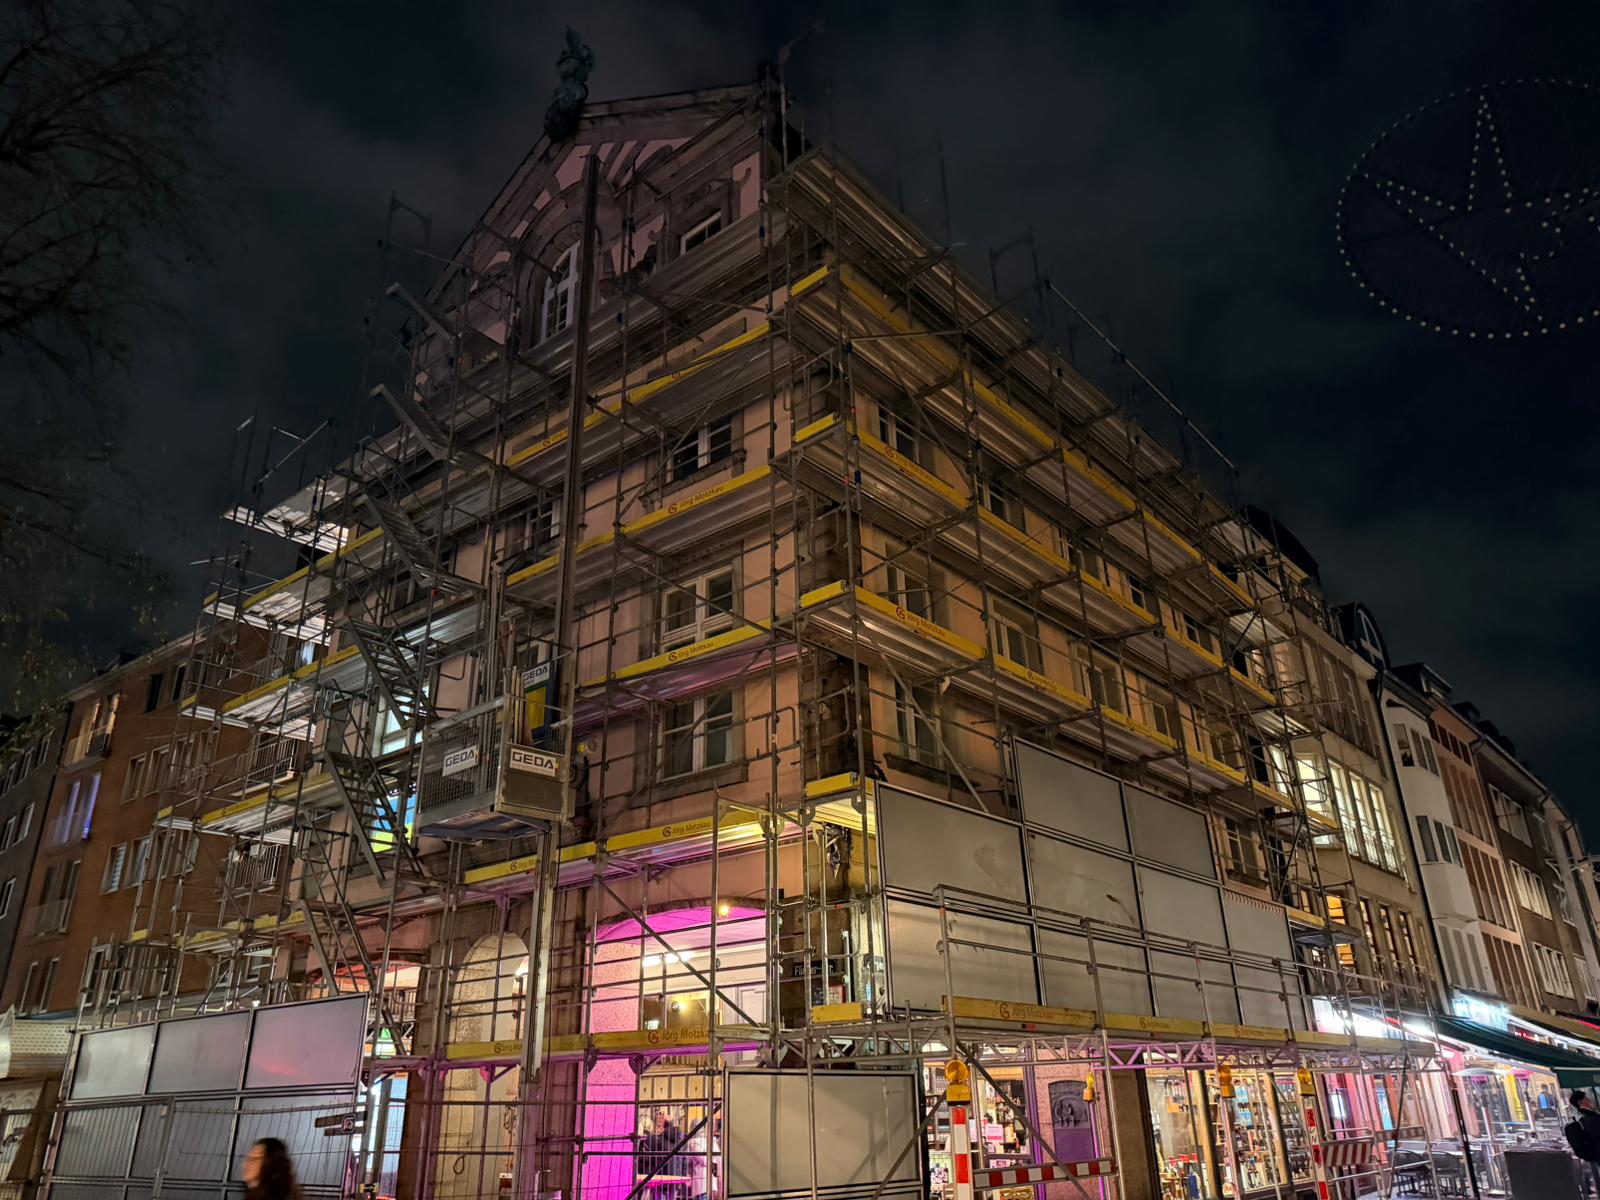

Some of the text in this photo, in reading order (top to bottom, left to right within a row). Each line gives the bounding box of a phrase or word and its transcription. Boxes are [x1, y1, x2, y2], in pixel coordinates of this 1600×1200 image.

[445, 749, 475, 767] GEDA
[512, 751, 554, 769] GEDA
[662, 1029, 678, 1042] Jörg
[680, 1027, 709, 1040] Motzk
